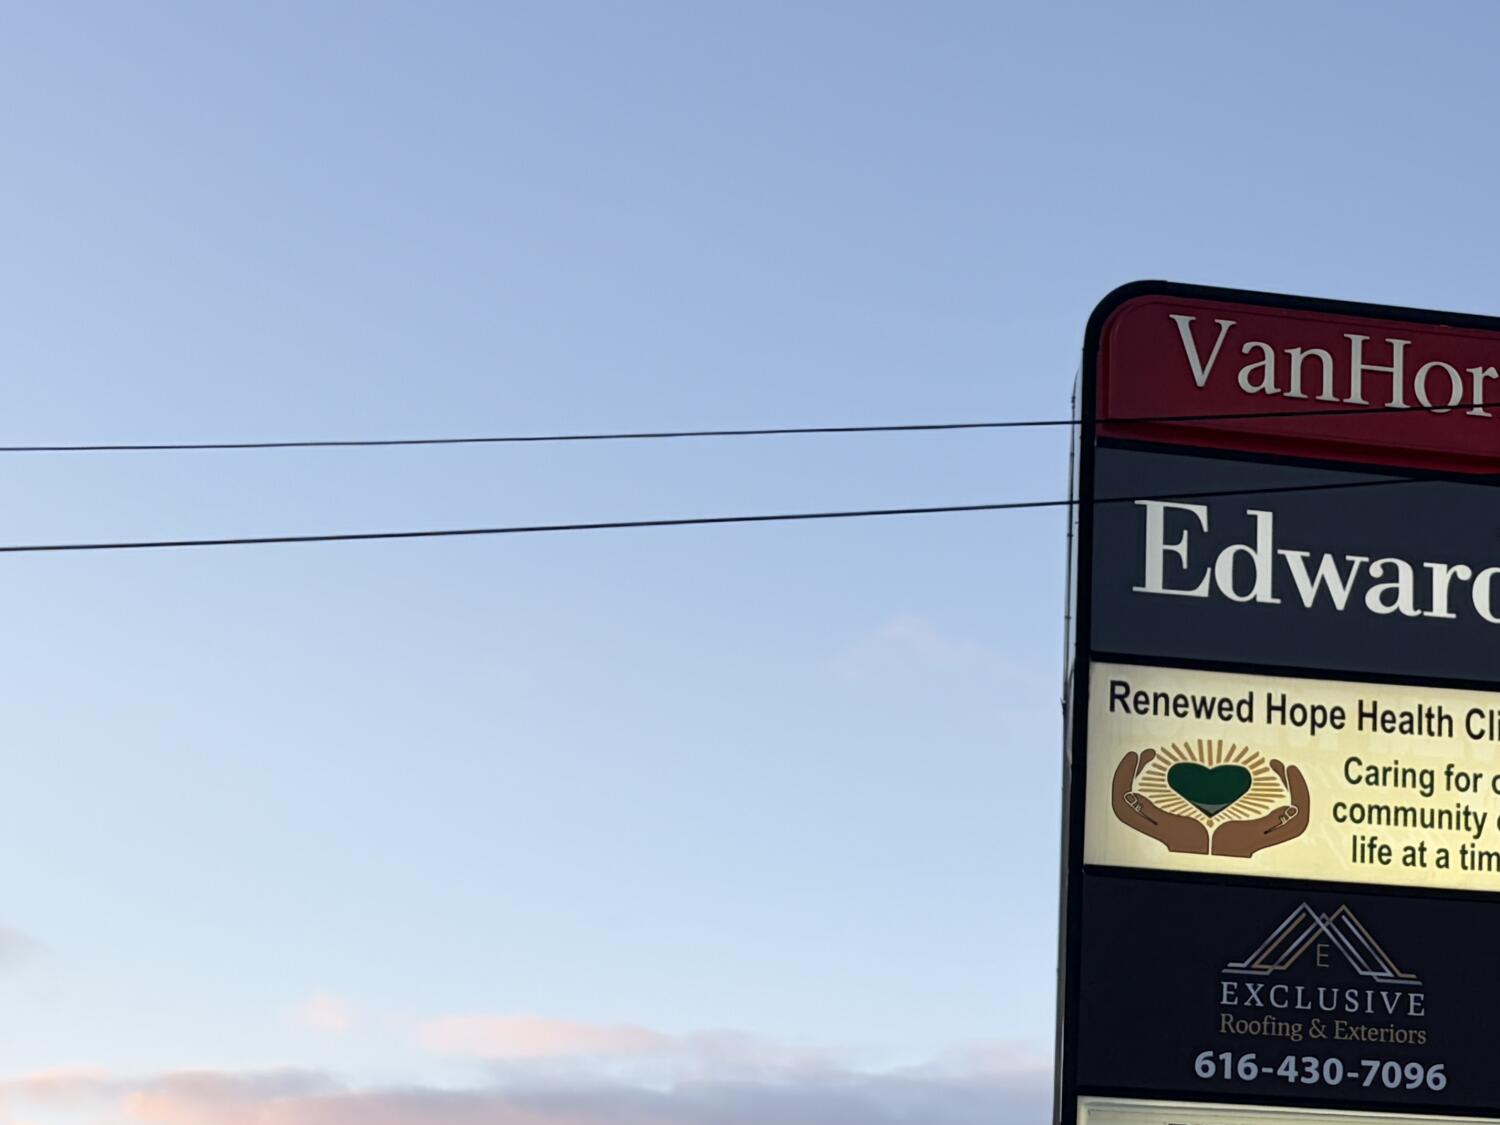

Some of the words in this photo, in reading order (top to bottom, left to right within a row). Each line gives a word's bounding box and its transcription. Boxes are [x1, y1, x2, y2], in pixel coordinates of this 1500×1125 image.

[1109, 680, 1254, 724] Renewed
[1266, 693, 1346, 735] Hope
[1357, 699, 1454, 738] Health
[1344, 757, 1435, 797] Caring
[1444, 763, 1483, 793] for
[1332, 801, 1488, 838] community
[1351, 836, 1393, 866] life
[1402, 841, 1427, 868] at
[1435, 847, 1450, 869] a
[1316, 943, 1330, 968] E
[1220, 981, 1426, 1017] EXCLUSIVE
[1220, 1013, 1303, 1042] Roofing
[1308, 1018, 1328, 1039] &
[1334, 1020, 1427, 1045] Exteriors
[1194, 1050, 1447, 1091] 616-430-7096
